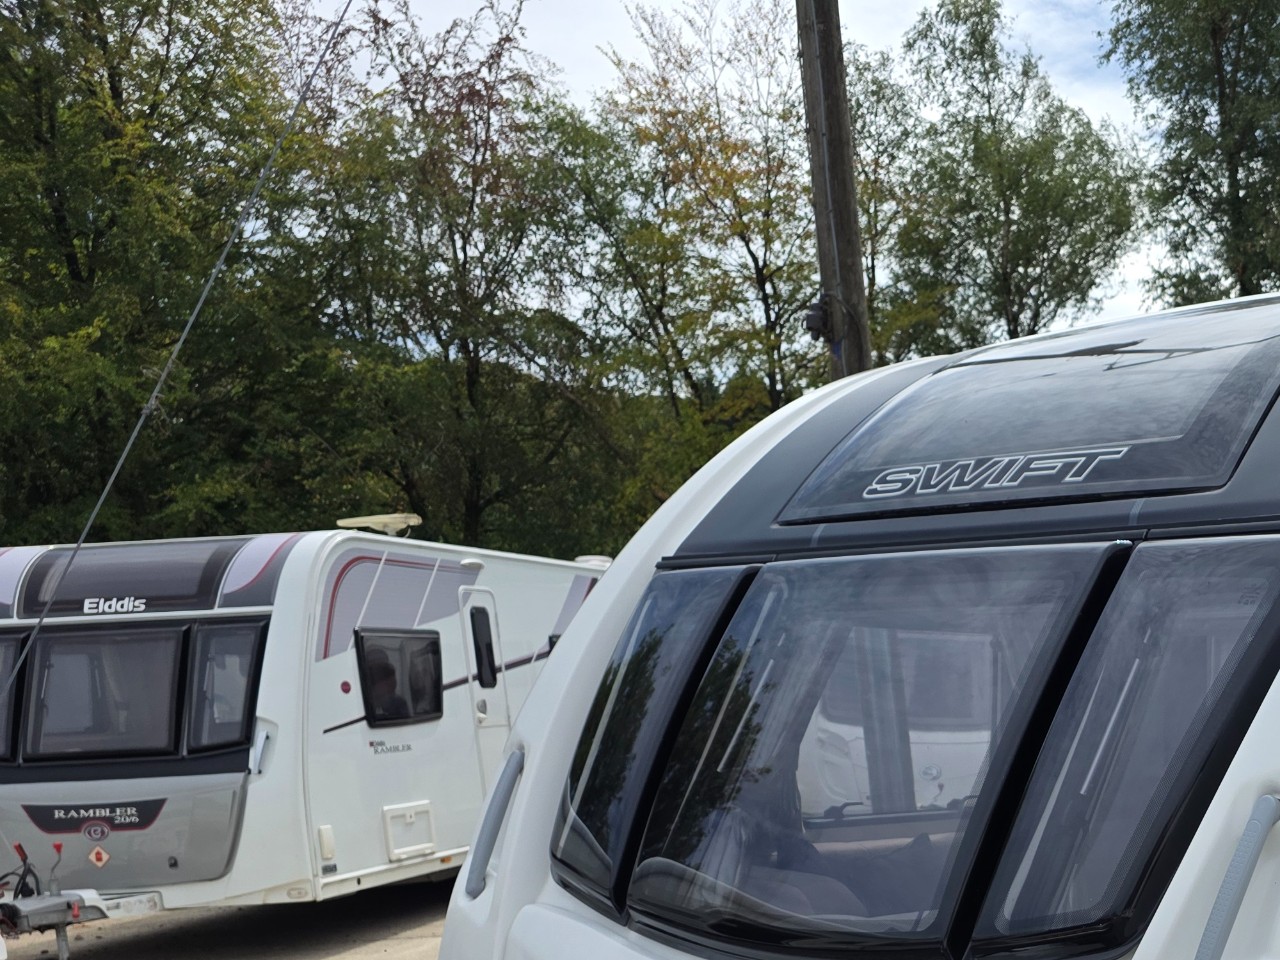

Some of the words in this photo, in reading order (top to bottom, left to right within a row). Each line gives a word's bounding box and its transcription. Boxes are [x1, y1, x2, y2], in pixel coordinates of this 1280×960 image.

[862, 445, 1132, 498] SWIFT
[83, 596, 147, 614] Elddis
[54, 807, 138, 819] RAMBLER
